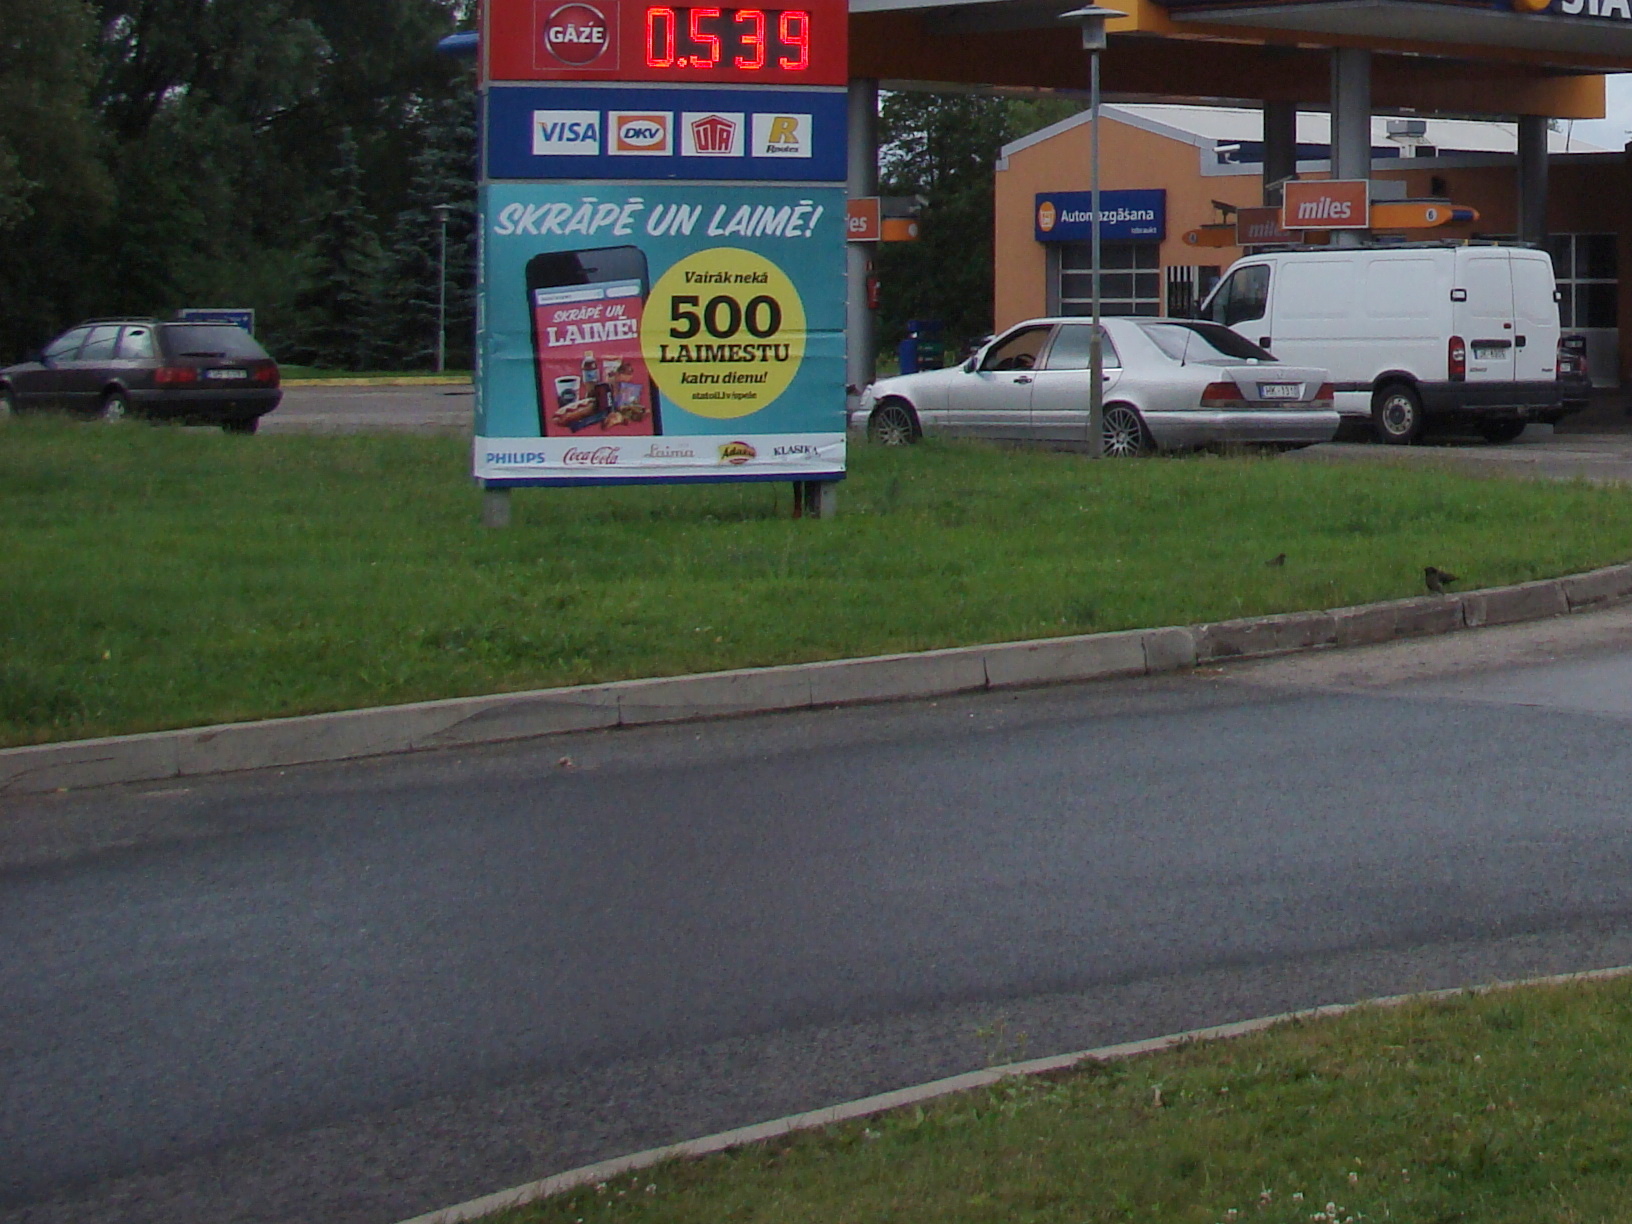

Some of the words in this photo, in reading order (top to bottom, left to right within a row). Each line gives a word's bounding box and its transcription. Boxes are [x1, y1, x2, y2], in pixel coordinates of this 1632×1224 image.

[646, 7, 809, 70] 0.539
[538, 121, 598, 143] VISA
[623, 127, 661, 139] DKV
[694, 116, 735, 152] UTA
[493, 197, 645, 236] SKRĀPĒ
[646, 204, 702, 236] UN
[706, 199, 824, 237] LAIMĒ!
[1298, 196, 1352, 219] miles
[685, 271, 732, 284] Vairāk
[734, 272, 769, 284] nekā
[552, 304, 604, 323] SKRĀPĒ
[605, 305, 626, 317] UN
[669, 294, 782, 339] 500
[547, 316, 638, 347] LAIMĒ!
[659, 343, 790, 363] LAIMESTU
[681, 372, 719, 384] katru
[722, 372, 768, 384] dienu!
[486, 452, 545, 464] PHILIPS
[644, 443, 695, 458] Laima
